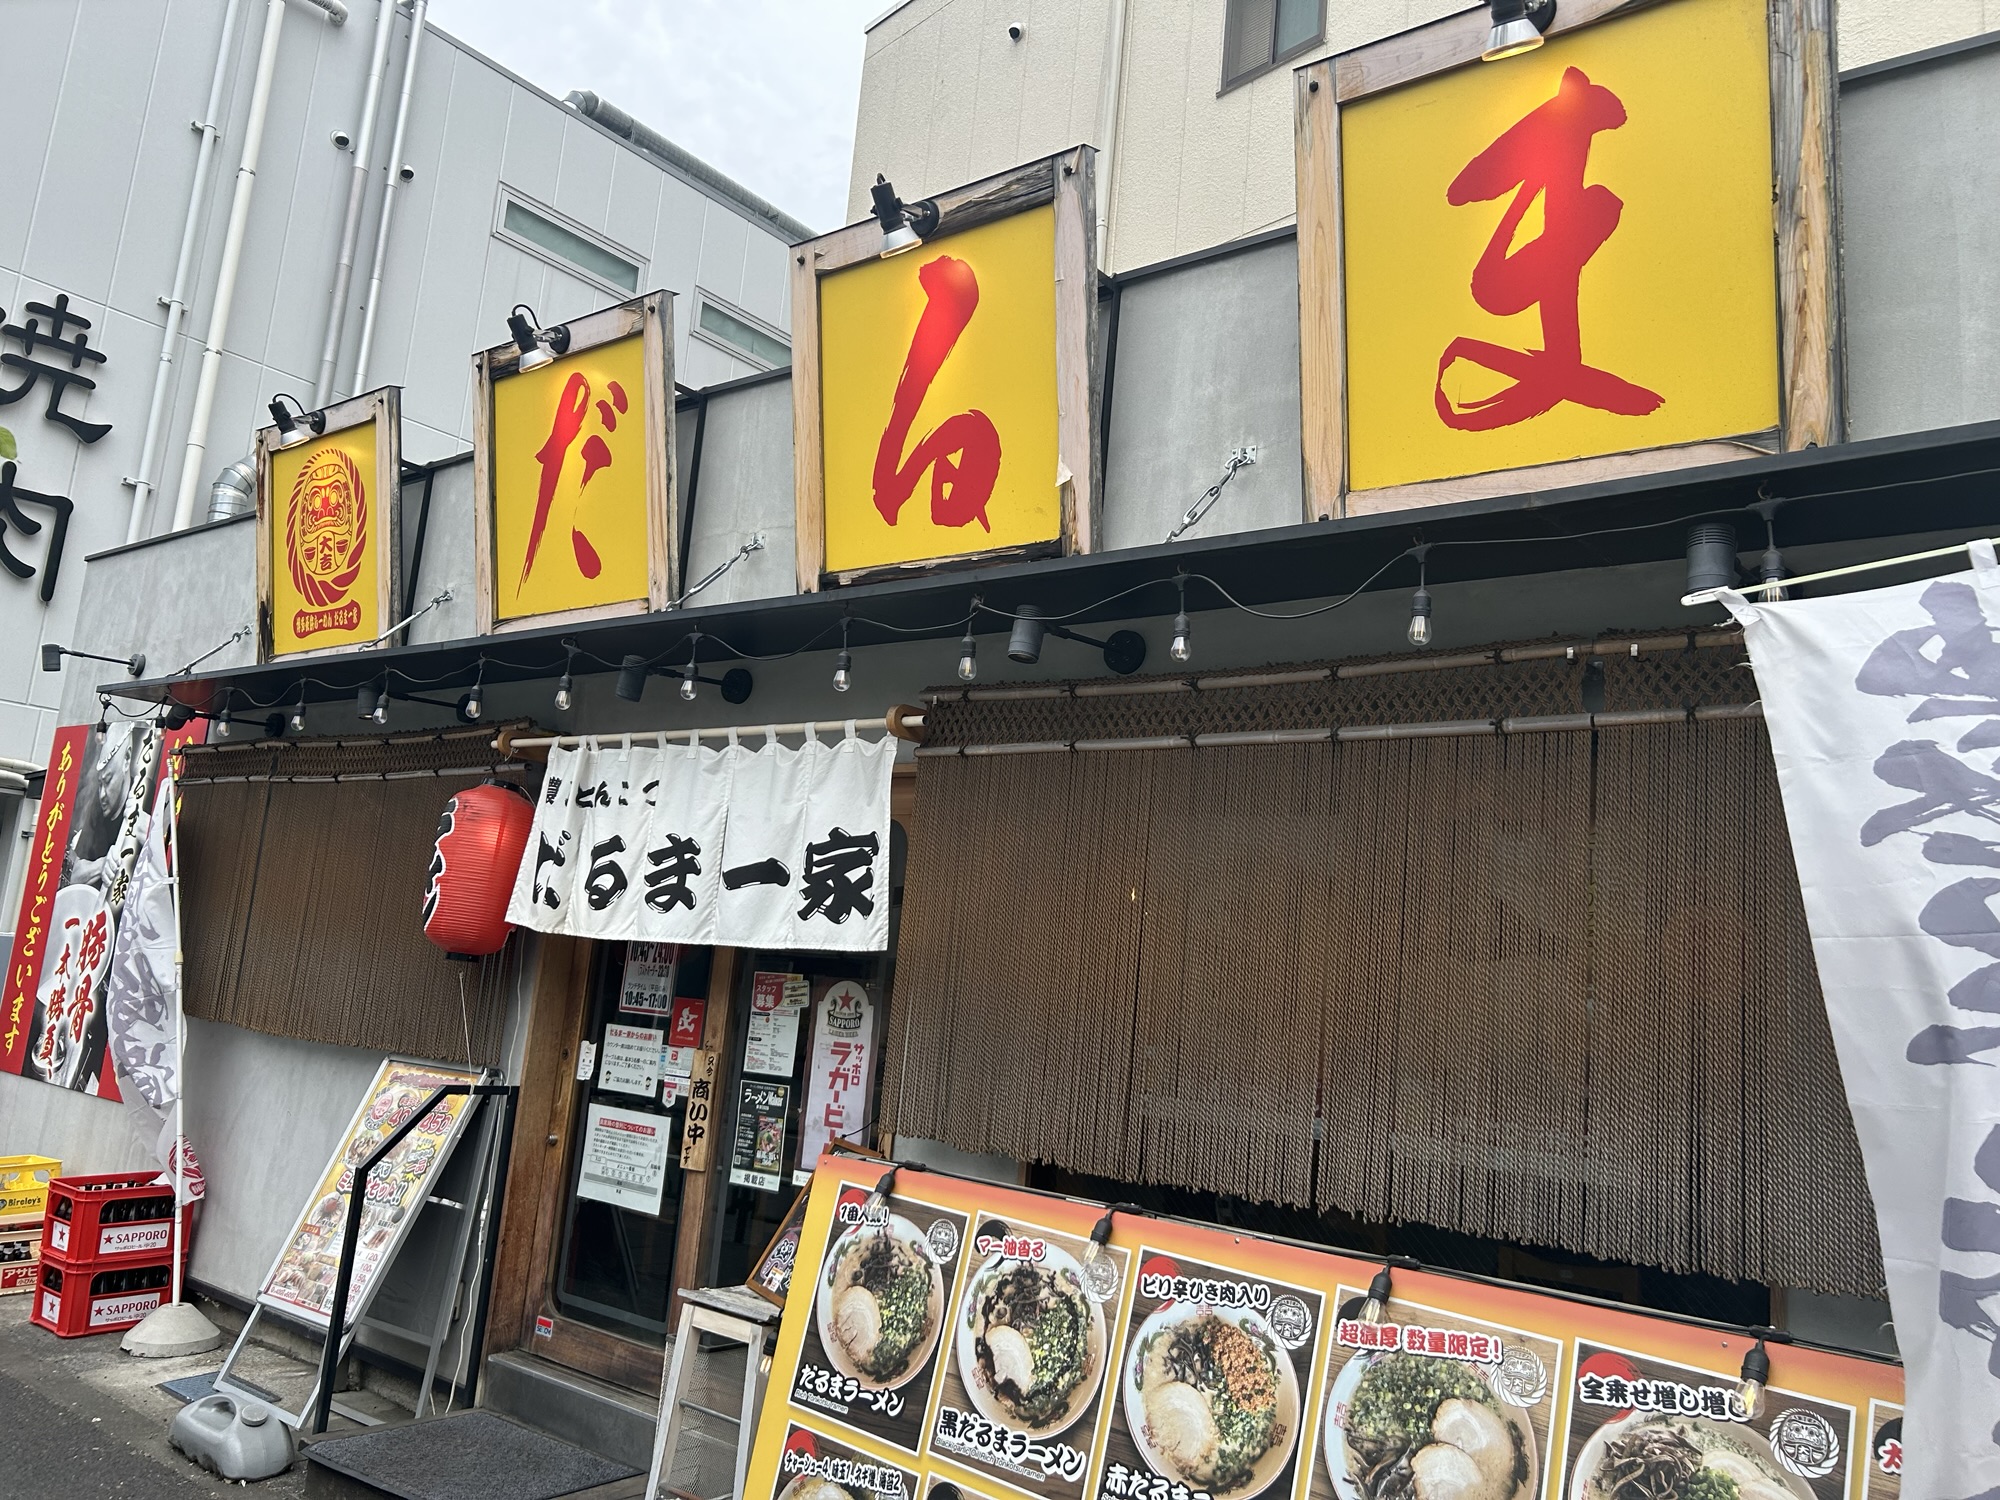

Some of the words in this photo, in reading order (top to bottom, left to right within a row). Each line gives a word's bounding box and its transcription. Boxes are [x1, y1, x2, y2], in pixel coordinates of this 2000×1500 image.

[319, 536, 333, 571] 大吉
[532, 827, 881, 925] だるま一家
[4, 740, 74, 1057] ありがとうございます
[67, 910, 107, 1044] 豚骨
[756, 984, 777, 993] スタッフ
[39, 917, 80, 1080] 一本勝負
[756, 994, 775, 1009] 募集
[828, 1015, 860, 1028] SAPPORO
[851, 1043, 865, 1086] サッポロ
[687, 1078, 711, 1146] 商い中
[822, 1041, 852, 1154] ラガービー
[743, 1173, 766, 1187] 掲載店
[116, 1229, 168, 1244] SAPPORO
[978, 1237, 1044, 1258] マー油香る
[4, 1267, 37, 1279] アサヒ
[1143, 1276, 1268, 1306] ピリ辛ひき肉入り
[106, 1300, 158, 1315] SAPPORO
[1340, 1321, 1398, 1348] 超濃厚
[1406, 1328, 1499, 1360] 数量限定!
[795, 1389, 807, 1400] Rich
[807, 1392, 831, 1408] Tonkotsu
[831, 1402, 848, 1414] ramen
[799, 1363, 905, 1417] だるまラーメン
[936, 1437, 951, 1449] Black
[980, 1451, 994, 1464] Rich
[994, 1457, 1023, 1475] Tonkotsu
[1023, 1468, 1045, 1481] ramen
[939, 1409, 1083, 1476] 黒だるまラーメン
[1106, 1463, 1211, 1500] 赤だるま
